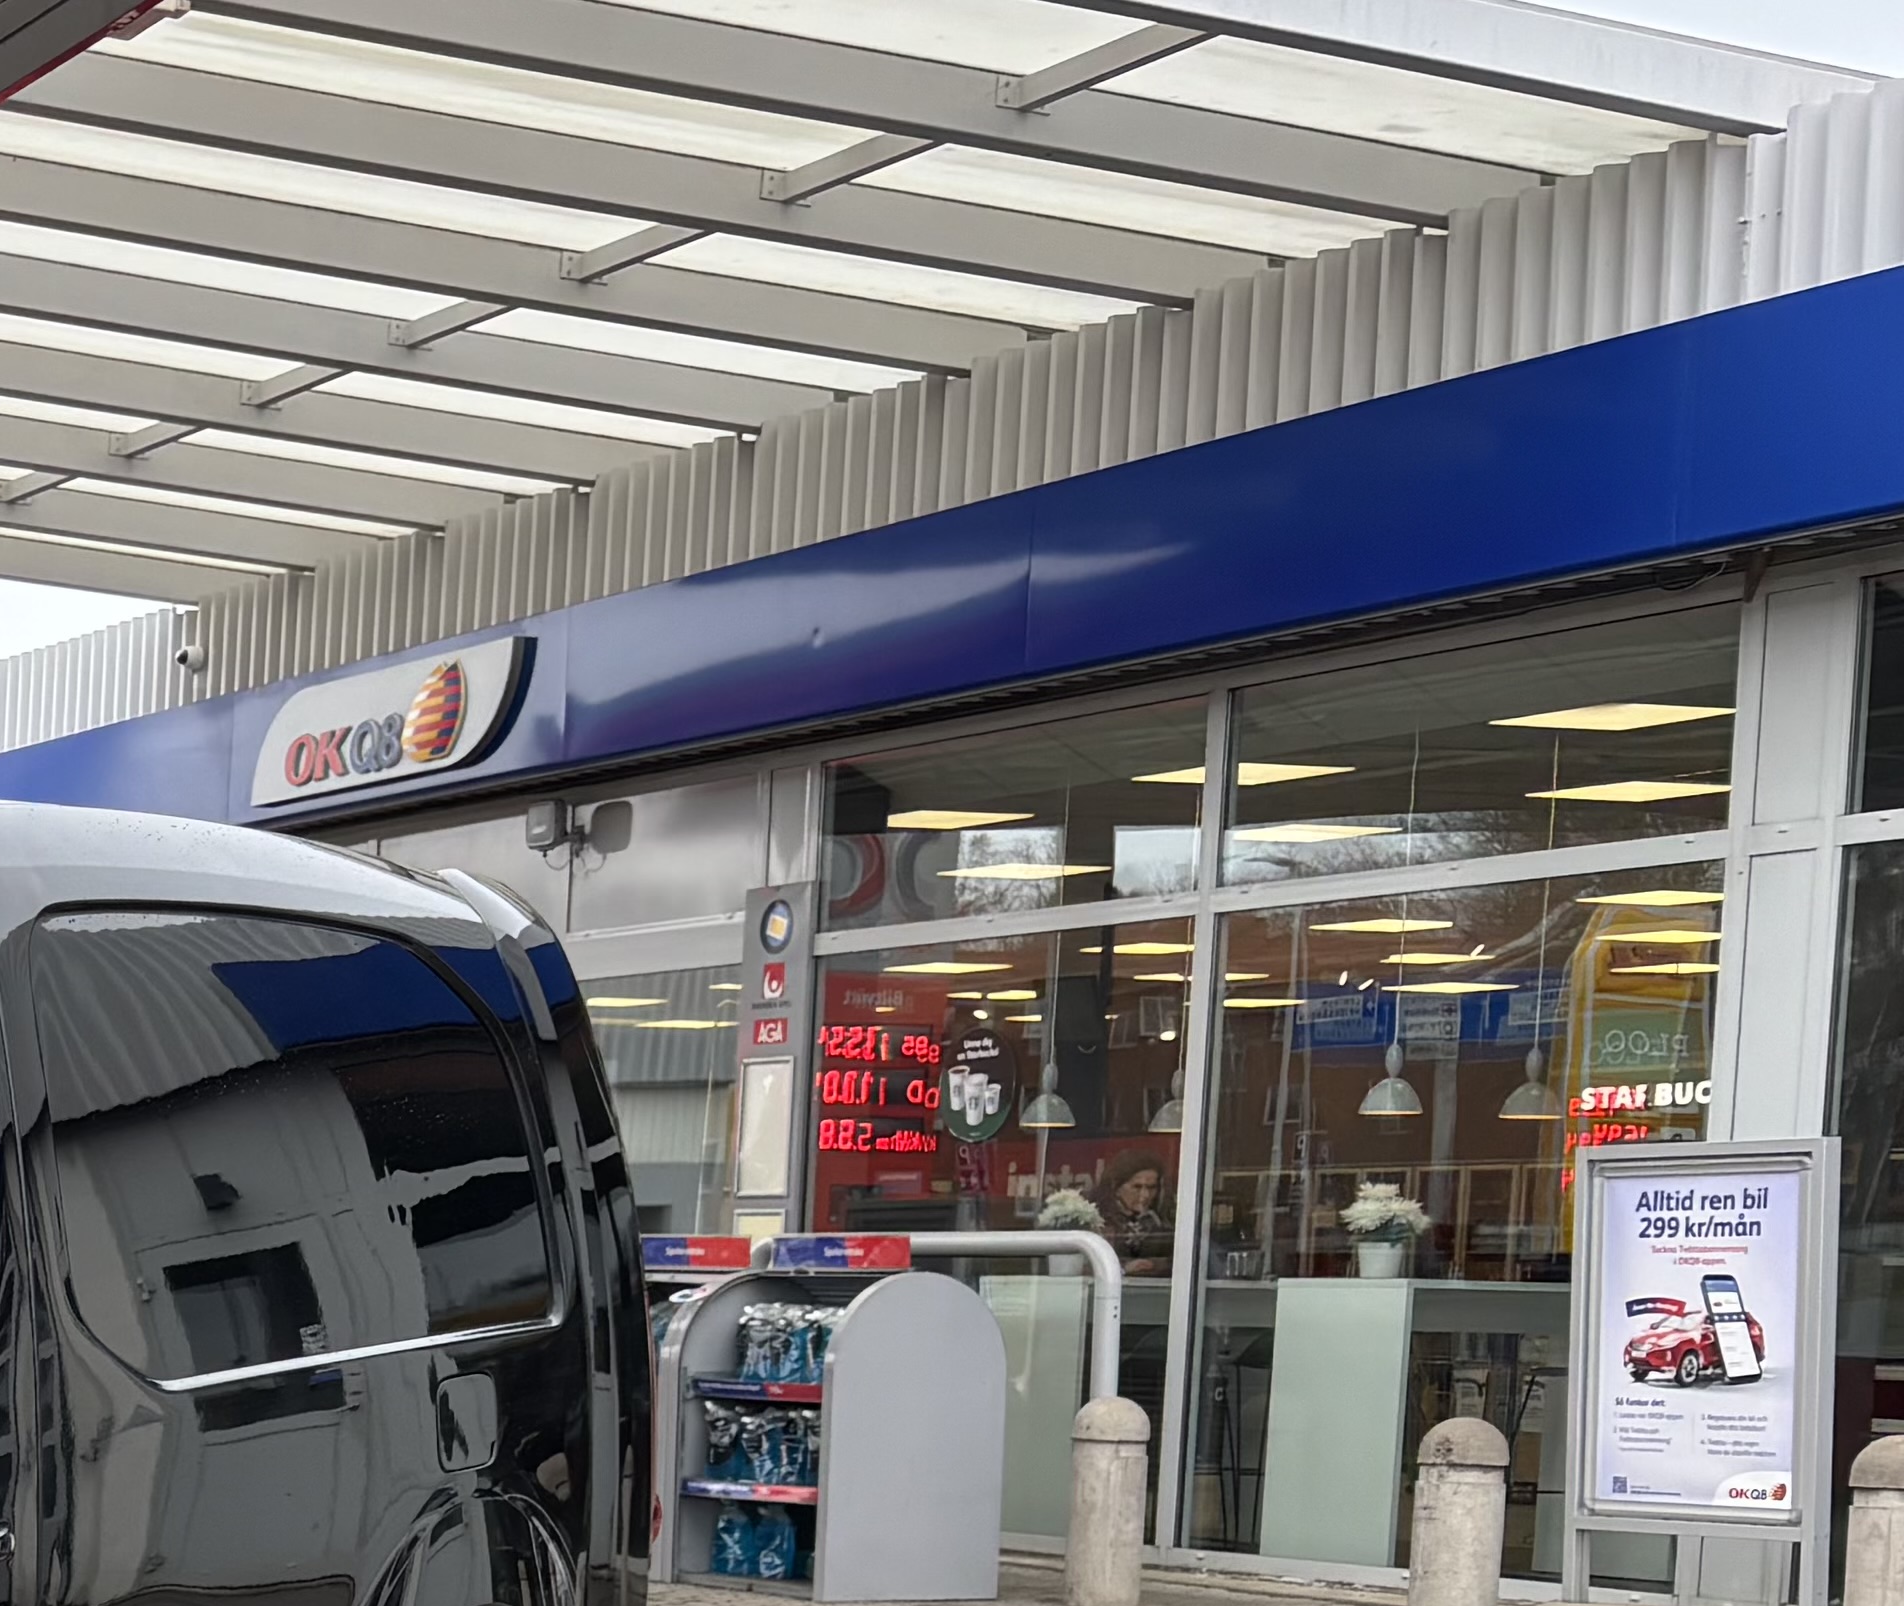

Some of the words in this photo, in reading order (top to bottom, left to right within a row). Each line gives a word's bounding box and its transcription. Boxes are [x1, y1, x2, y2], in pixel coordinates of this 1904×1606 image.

[757, 1020, 784, 1044] AGA
[1635, 1189, 1695, 1213] Alltid
[1700, 1193, 1736, 1211] ren
[1743, 1187, 1769, 1210] bil
[1638, 1217, 1680, 1238] 299
[1684, 1213, 1762, 1238] kr/mån
